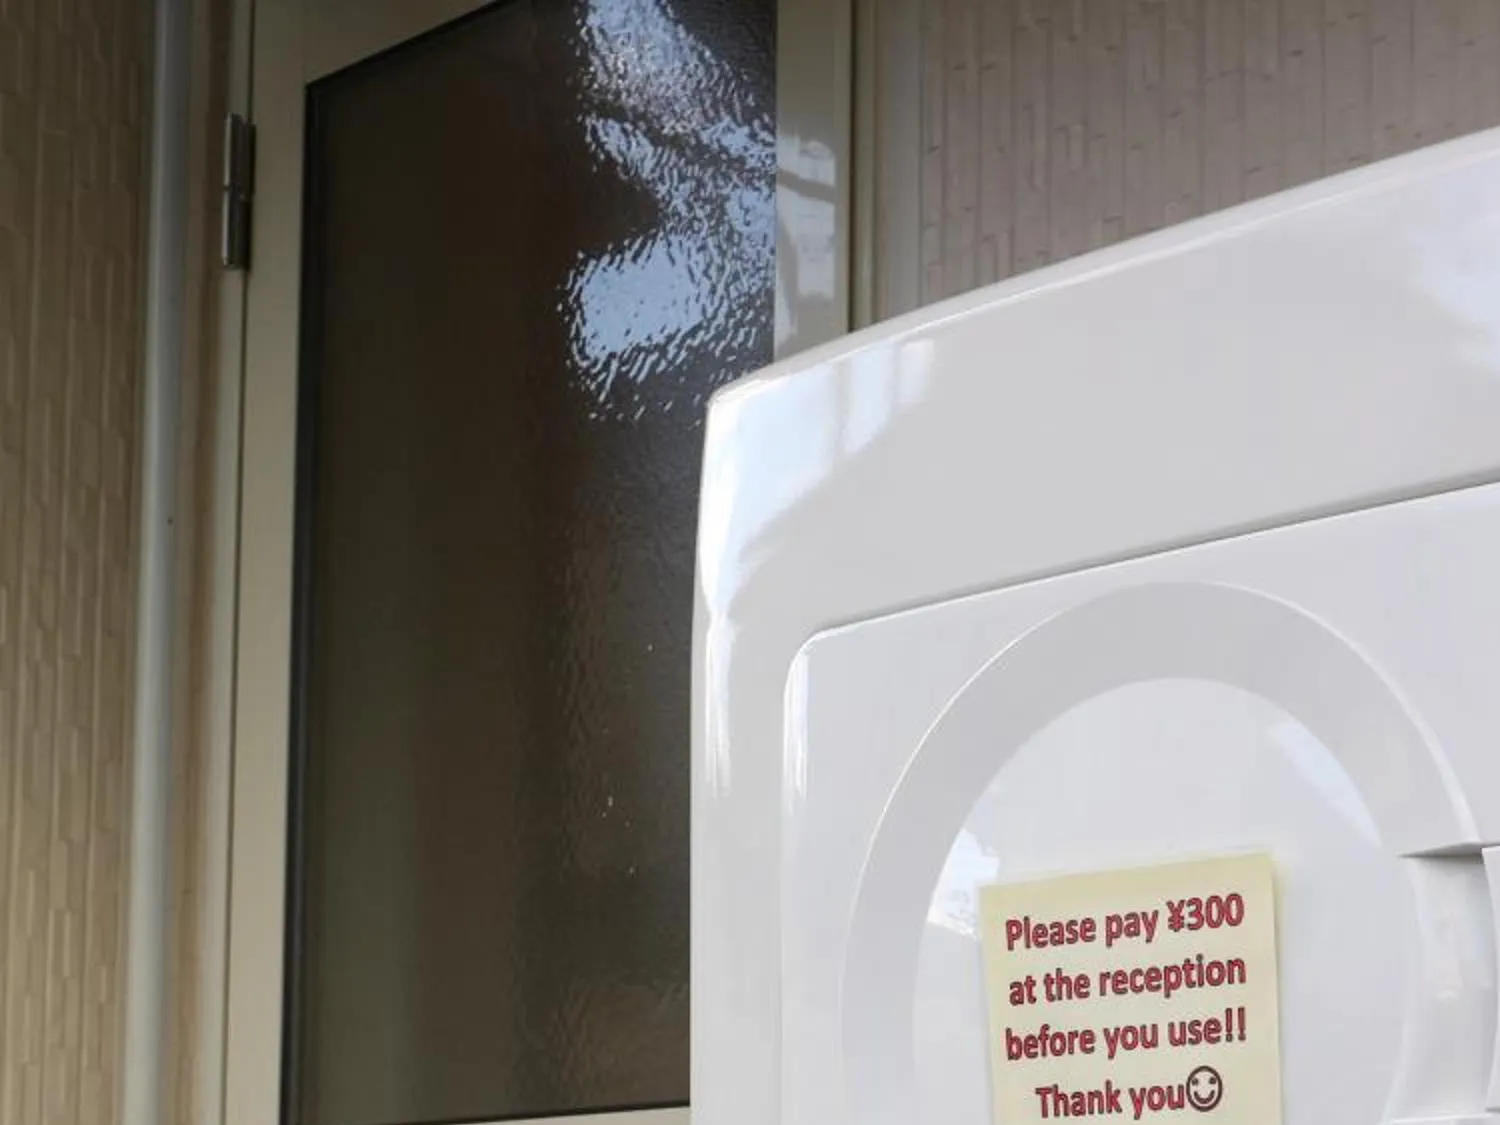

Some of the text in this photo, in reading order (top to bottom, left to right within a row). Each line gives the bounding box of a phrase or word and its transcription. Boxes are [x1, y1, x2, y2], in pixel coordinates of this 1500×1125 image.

[1005, 893, 1245, 951] Please pay ¥300
[1009, 953, 1247, 1006] at the reception
[1005, 1006, 1247, 1060] before you use!!
[1035, 1079, 1186, 1120] Thank you
